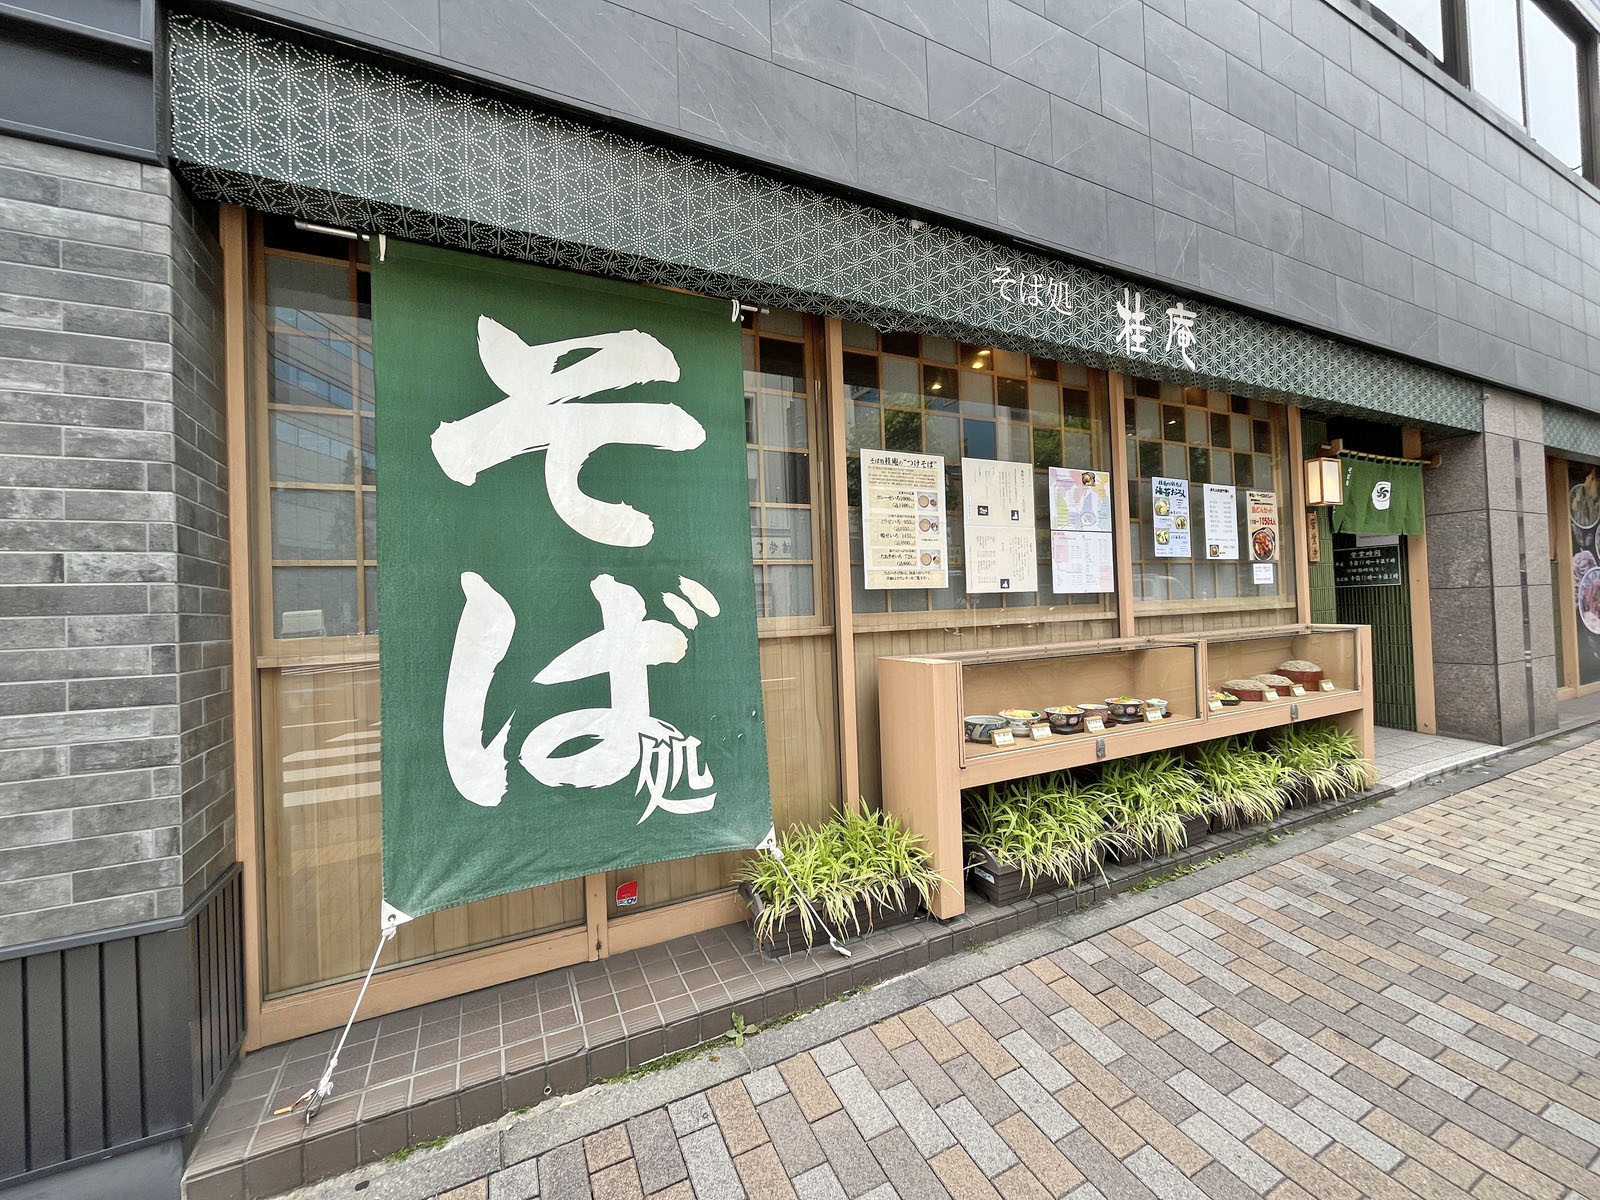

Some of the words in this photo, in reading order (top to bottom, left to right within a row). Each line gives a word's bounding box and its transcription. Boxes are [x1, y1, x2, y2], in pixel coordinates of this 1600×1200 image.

[992, 265, 1073, 316] そば処
[1116, 287, 1197, 371] 桂庵
